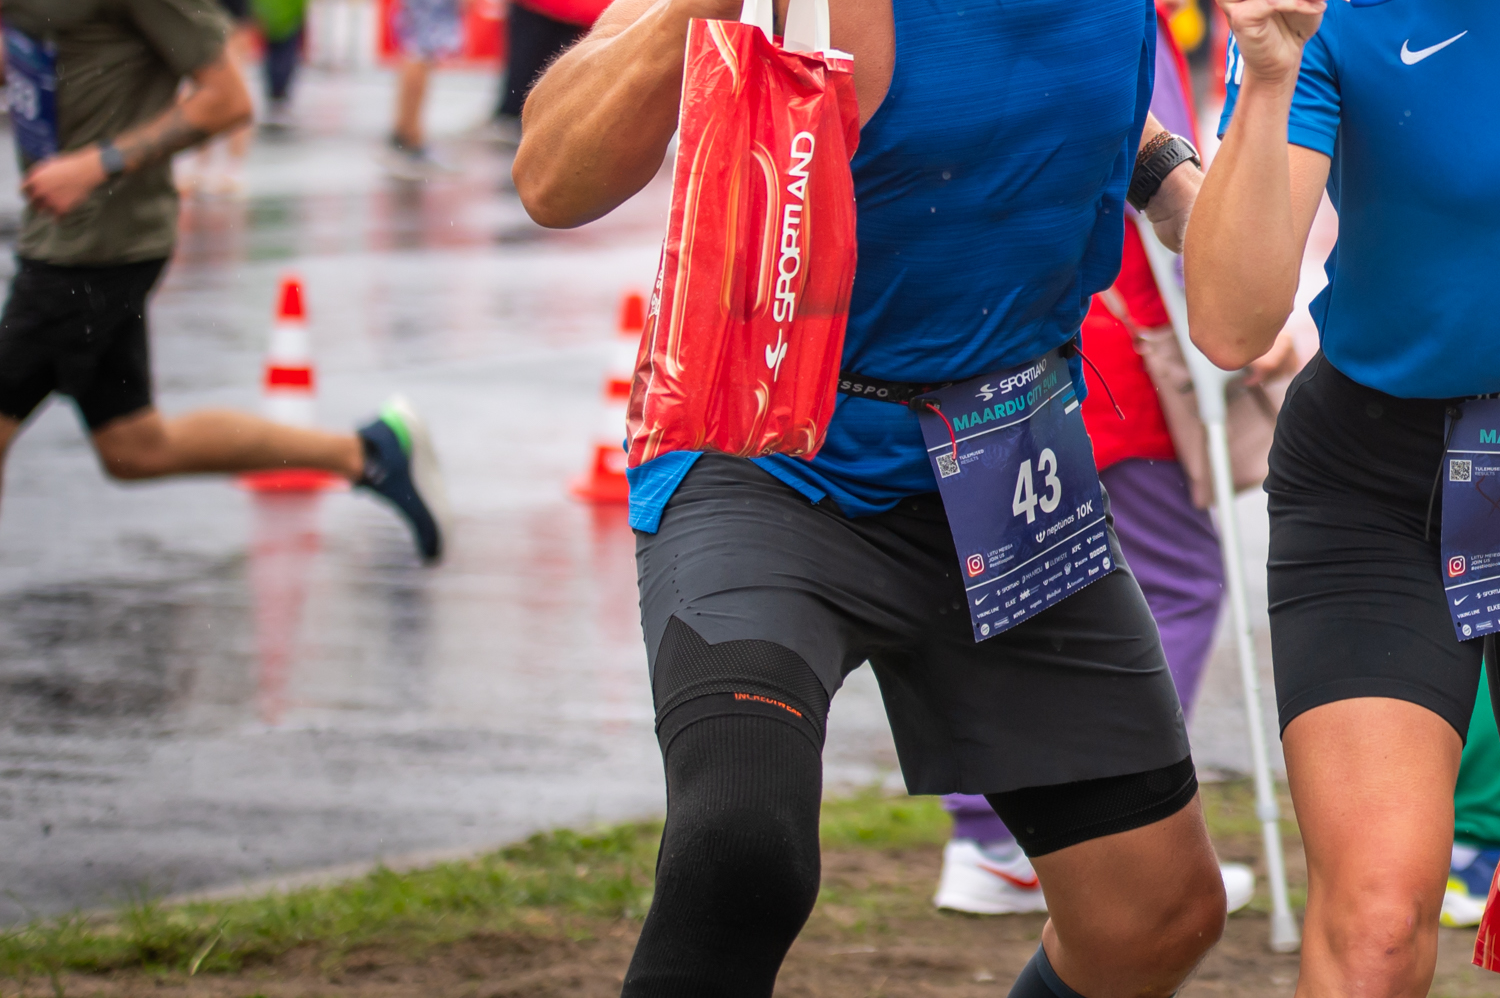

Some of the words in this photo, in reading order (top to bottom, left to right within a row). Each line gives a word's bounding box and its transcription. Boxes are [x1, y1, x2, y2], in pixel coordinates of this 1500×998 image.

[999, 358, 1047, 394] SPORTLAND
[952, 395, 1026, 432] MAARDU
[1027, 384, 1043, 406] CITY
[1043, 371, 1058, 393] RUN
[1012, 448, 1062, 524] 43
[1075, 500, 1094, 522] 10K
[1071, 543, 1082, 554] KFC
[1487, 604, 1500, 612] ELKE
